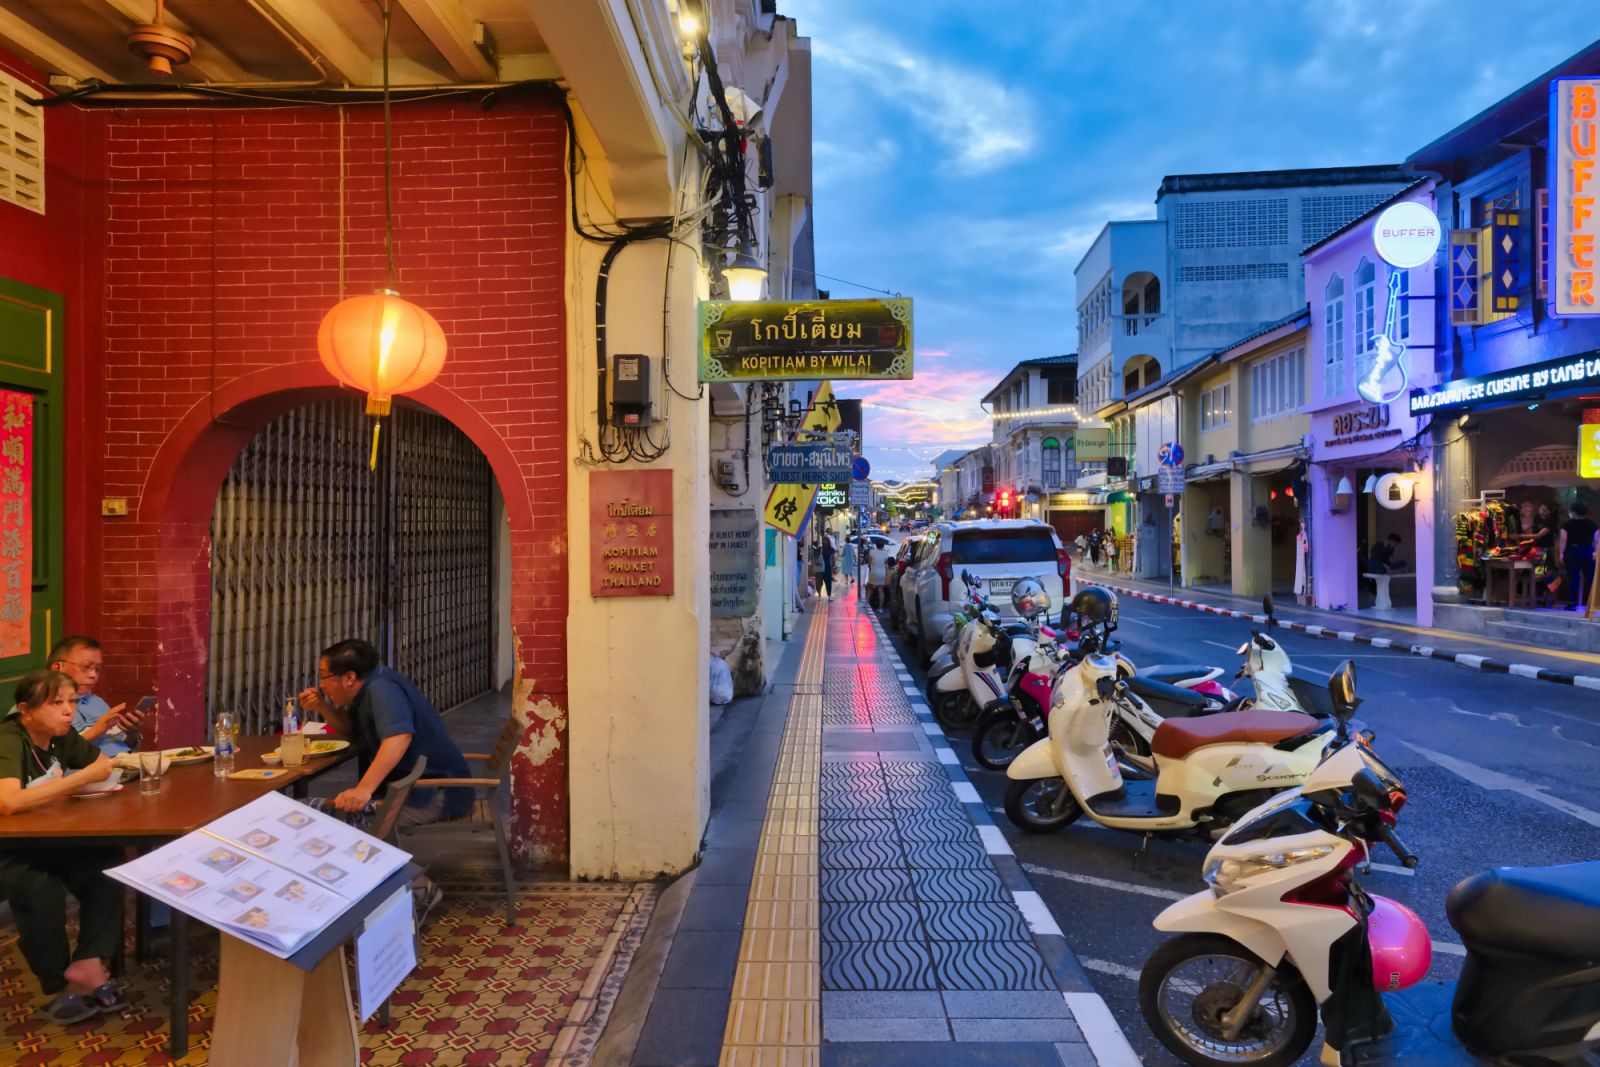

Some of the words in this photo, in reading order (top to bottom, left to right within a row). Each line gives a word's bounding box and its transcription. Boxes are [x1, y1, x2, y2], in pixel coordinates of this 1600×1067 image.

[1571, 85, 1597, 305] BUFFER
[1382, 228, 1435, 238] BUFFER
[742, 356, 805, 370] KOPITIAM
[810, 356, 828, 368] BY
[831, 354, 871, 368] WILAI
[771, 471, 800, 481] OLDEST
[802, 471, 828, 481] HERBS
[829, 471, 851, 481] SHOP
[817, 489, 846, 497] akiniku
[604, 546, 659, 558] KOPITIAM
[608, 561, 656, 573] PHUKET
[603, 575, 662, 588] THAILAND
